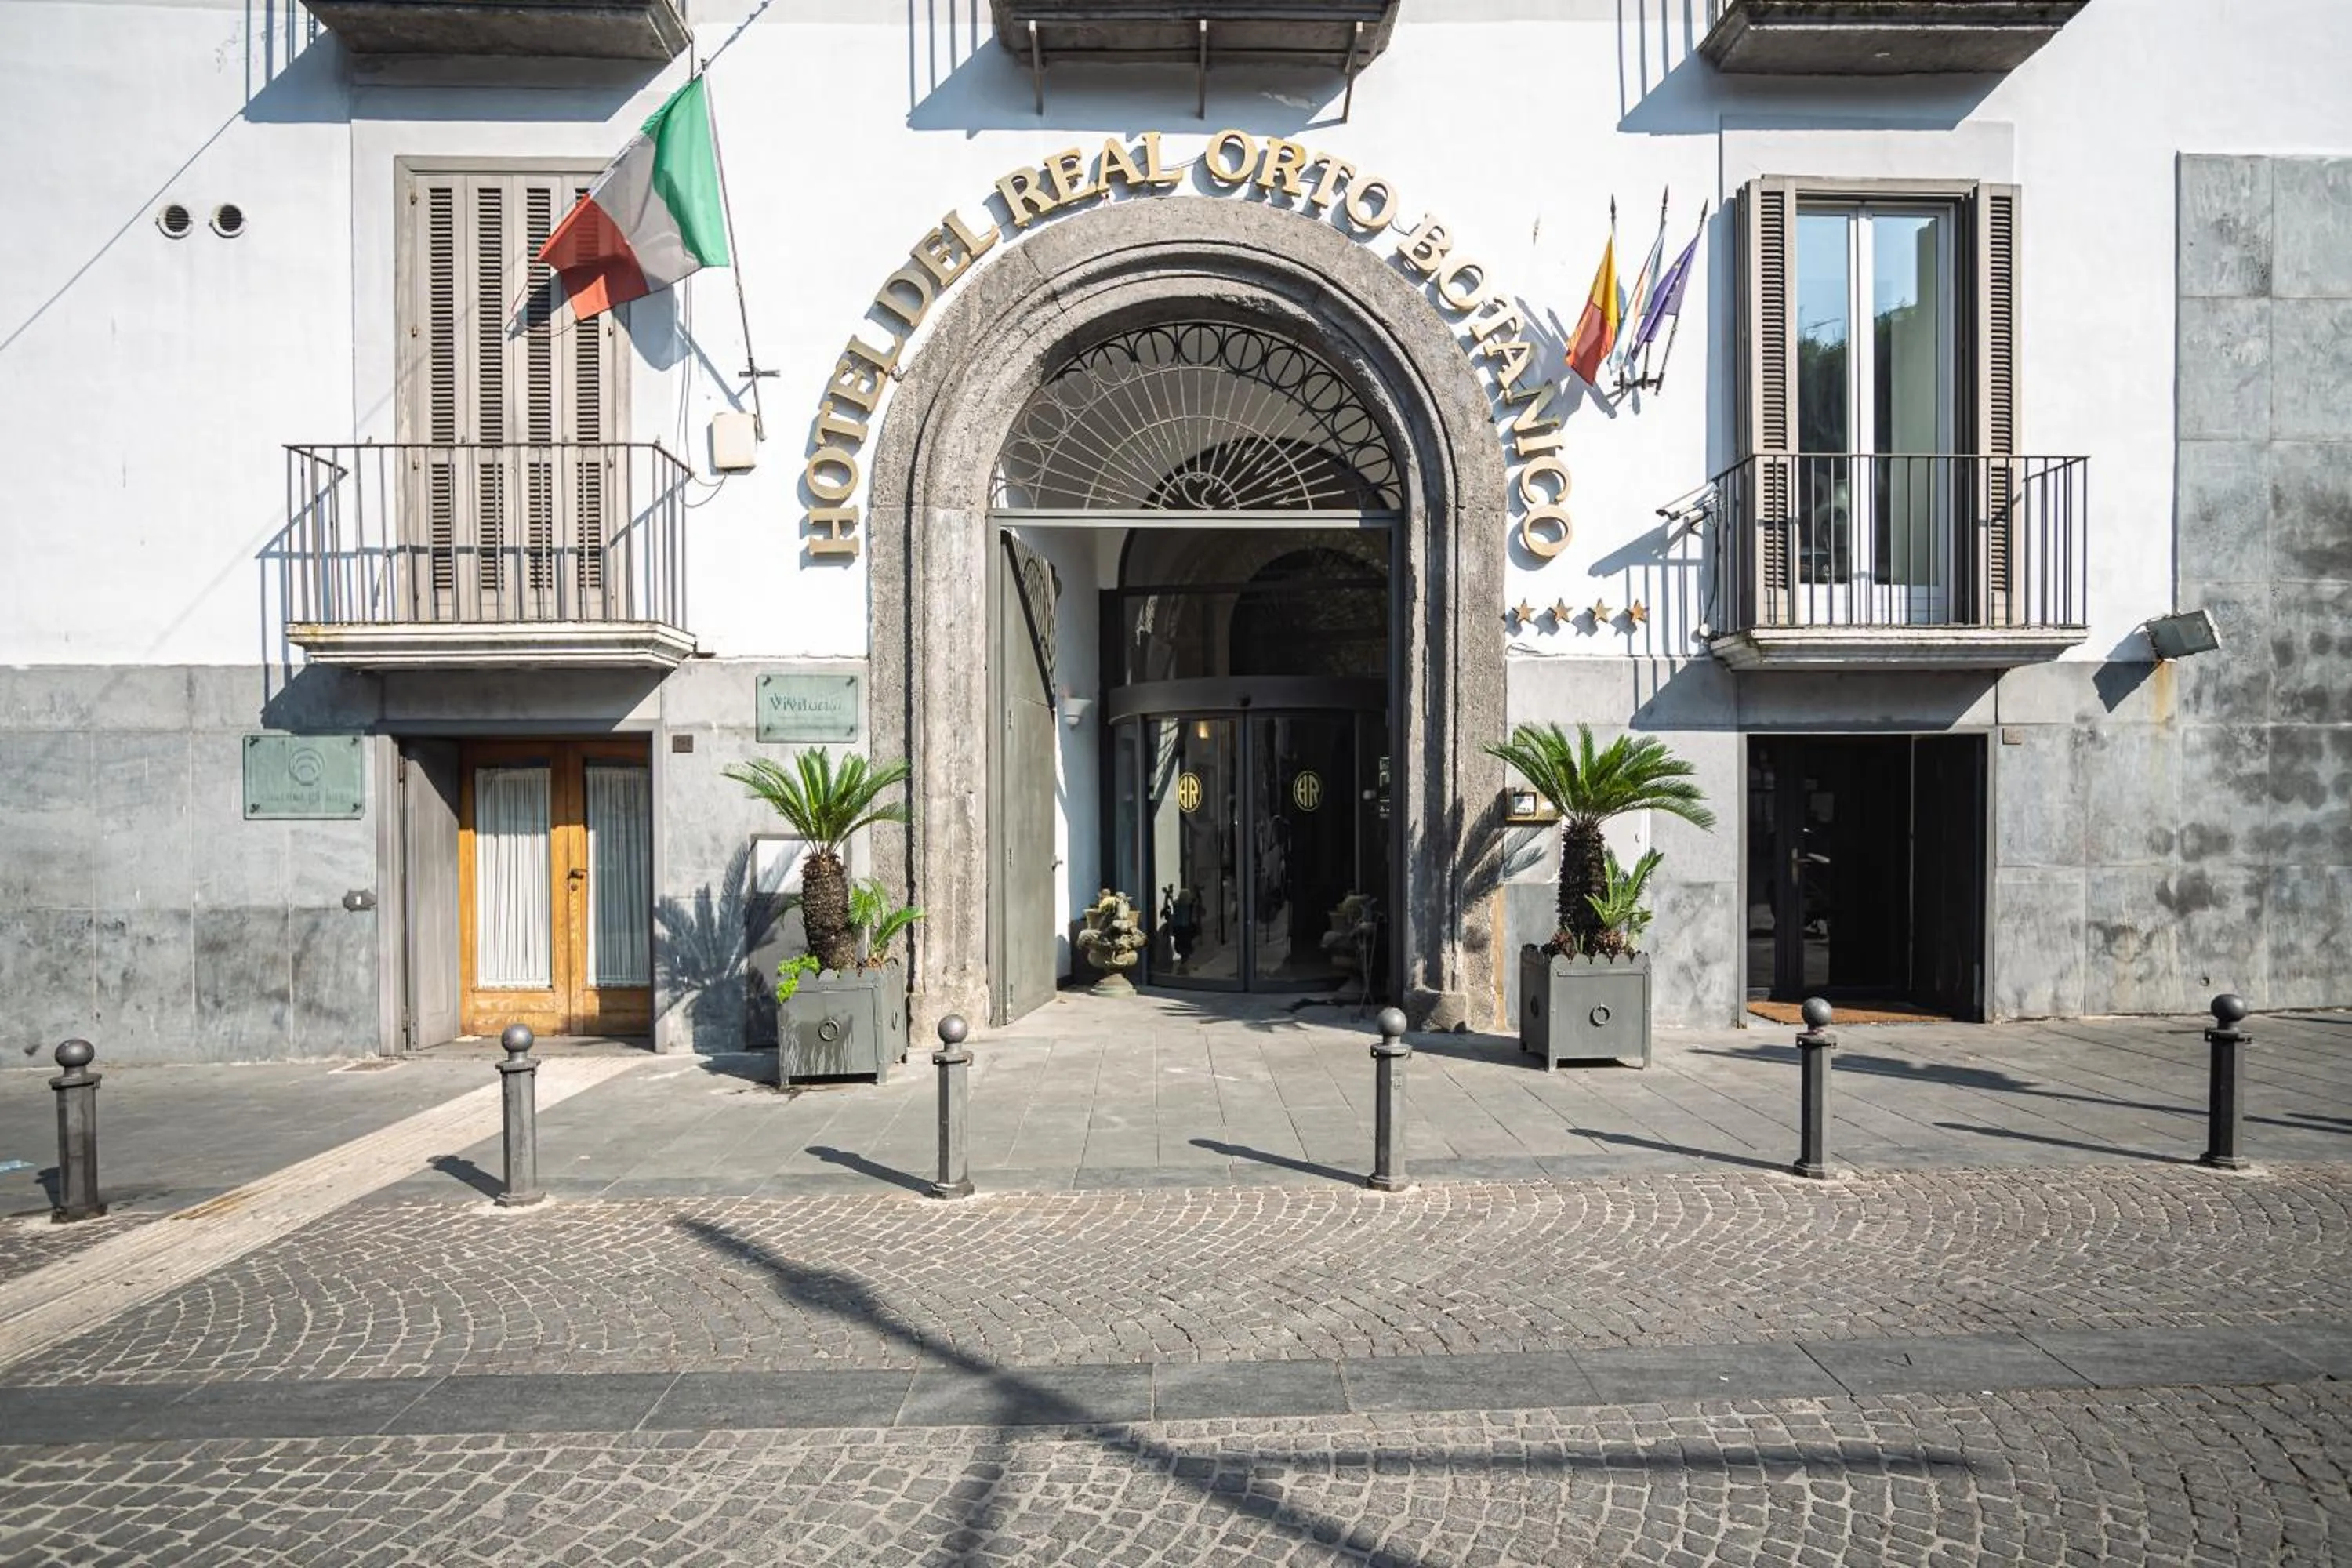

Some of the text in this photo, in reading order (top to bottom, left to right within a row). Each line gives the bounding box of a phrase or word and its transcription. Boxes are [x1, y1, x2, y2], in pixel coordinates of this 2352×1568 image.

[803, 129, 1572, 558] HOTEL DEL REAL ORTO BOTANICO
